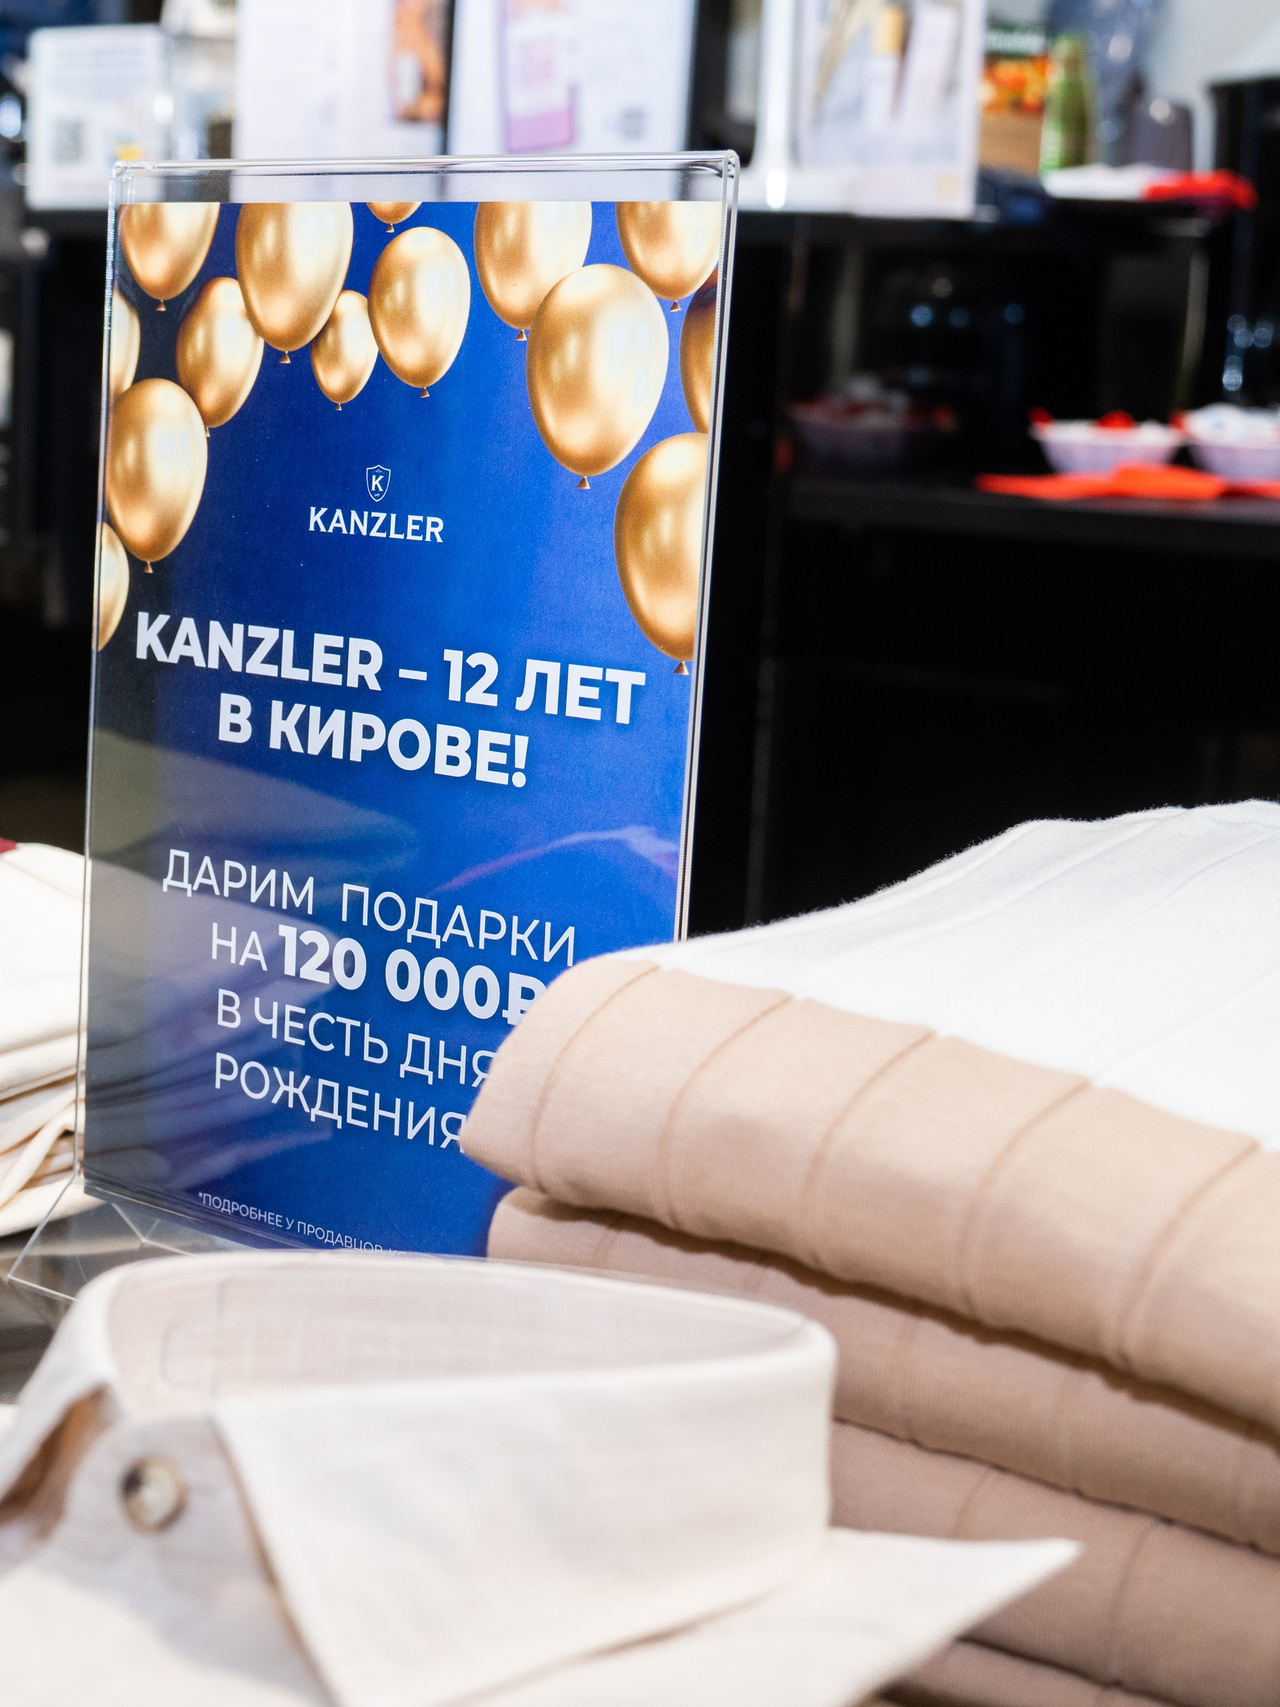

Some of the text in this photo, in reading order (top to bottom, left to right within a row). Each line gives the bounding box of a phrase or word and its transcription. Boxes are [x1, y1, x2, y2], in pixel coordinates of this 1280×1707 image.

[308, 506, 445, 543] KANZLER
[371, 474, 384, 492] K
[135, 611, 383, 691] KANZLER
[443, 648, 499, 707] 12
[515, 658, 646, 724] ЛЕТ
[219, 692, 529, 788] В КИРОВЕ!
[162, 848, 576, 967] ДАРИМ ПОДАРКИ
[211, 922, 268, 971] НА
[278, 924, 367, 991] 120
[217, 988, 498, 1088] В ЧЕСТЬ ДНЯ
[215, 1052, 467, 1154] РОЖДЕНИЯ
[286, 1217, 295, 1230] У
